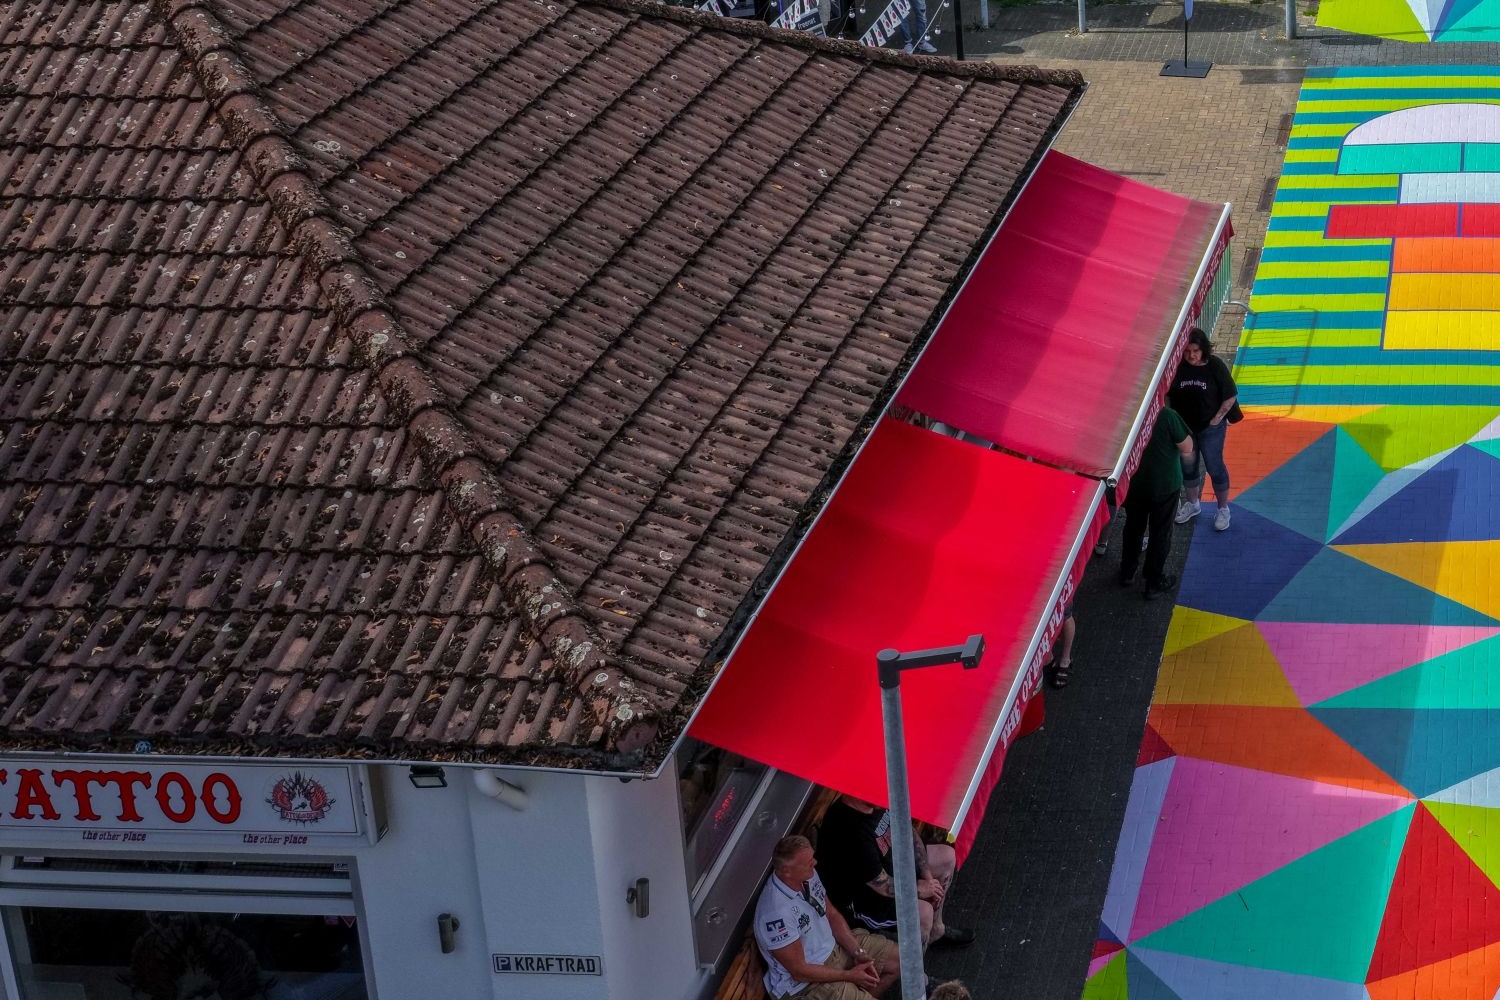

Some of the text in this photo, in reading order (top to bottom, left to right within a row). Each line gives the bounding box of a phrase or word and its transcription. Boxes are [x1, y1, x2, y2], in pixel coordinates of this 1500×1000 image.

[0, 769, 243, 824] ATTOO
[82, 830, 97, 841] the
[99, 832, 121, 841] other
[243, 834, 258, 844] the
[260, 835, 282, 844] other
[514, 957, 595, 973] KRAFTRAD
